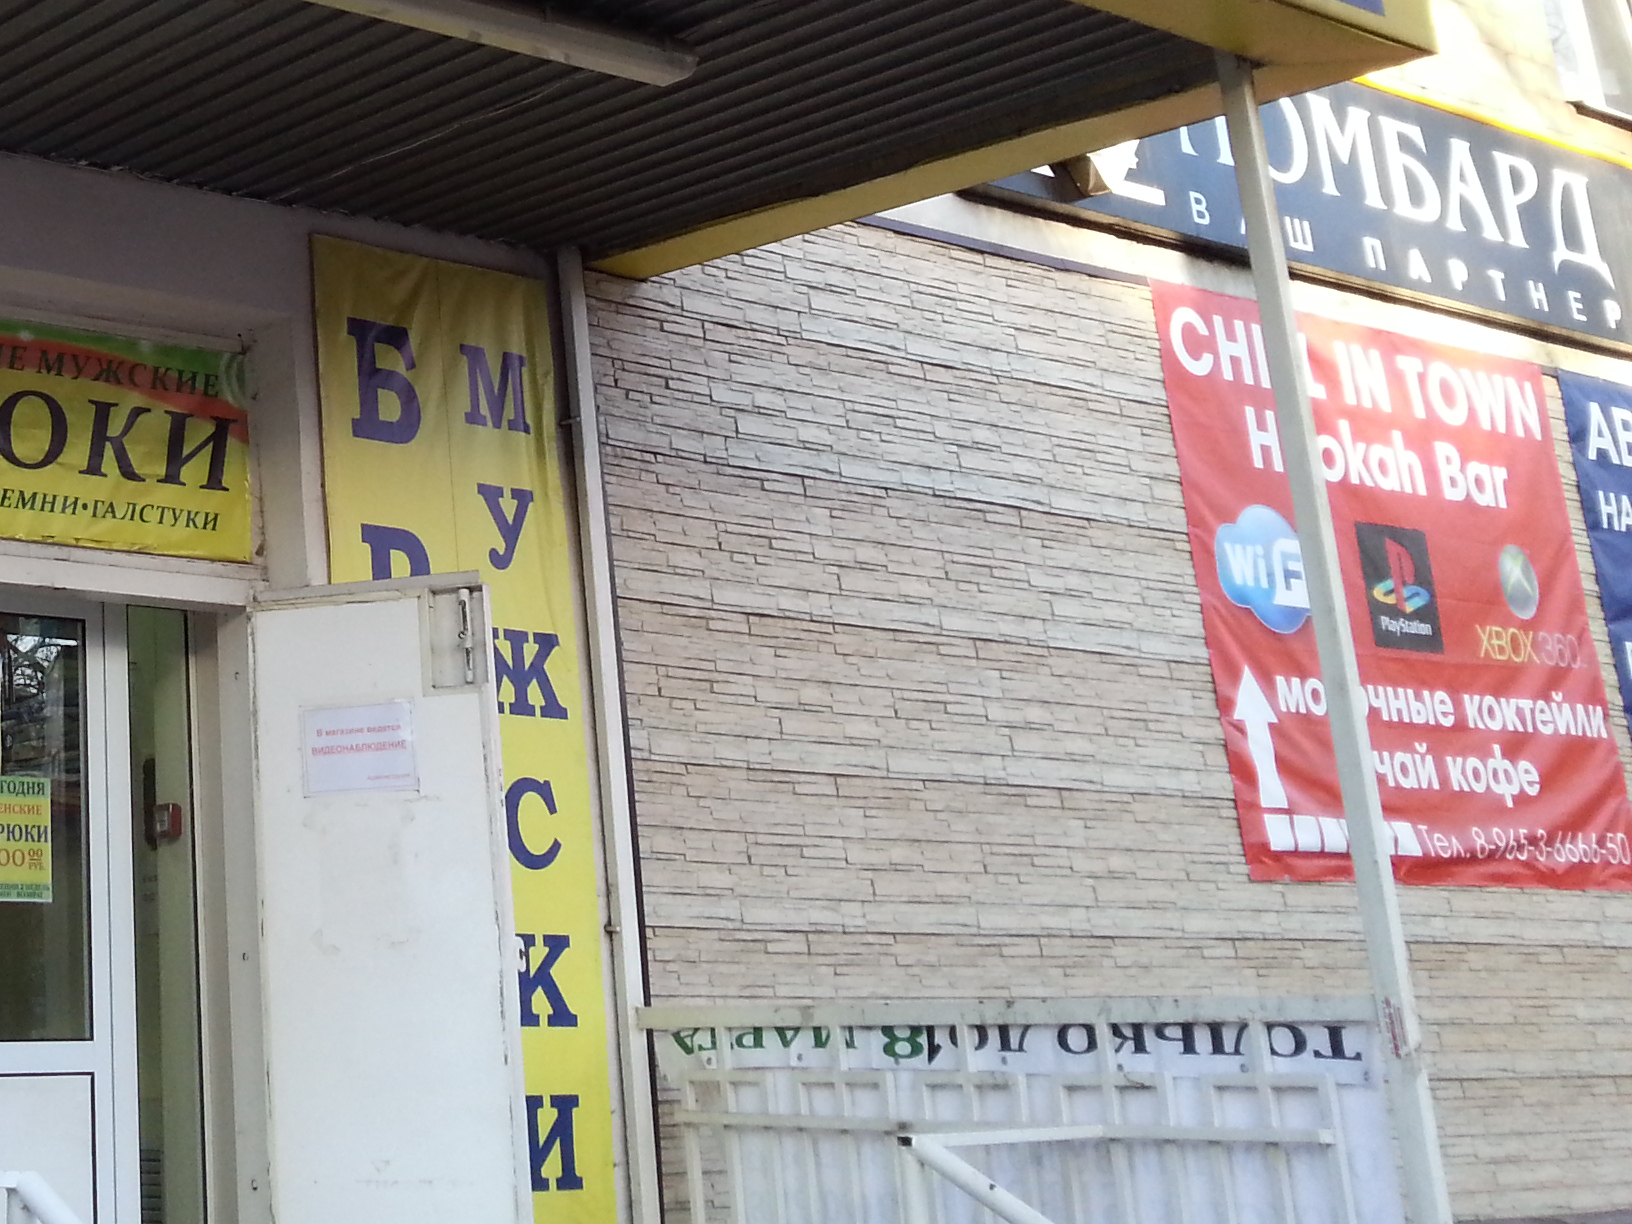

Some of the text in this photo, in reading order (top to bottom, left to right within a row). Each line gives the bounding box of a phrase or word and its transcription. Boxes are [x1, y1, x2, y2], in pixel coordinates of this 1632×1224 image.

[1189, 190, 1622, 329] ВШ ПАРТНЕР
[36, 349, 221, 398] МУЖСКИЕ
[1169, 307, 1542, 441] CHIL IN TOWN
[1245, 407, 1509, 509] Hokah Bar
[91, 499, 220, 532] ГАЛСТУКИ
[1380, 616, 1434, 637] PlayStation
[1476, 625, 1539, 664] XBOX
[1275, 675, 1608, 738] мочные коктейли
[311, 739, 407, 756] ВИДЕОНАБЛЮДЕНИЕ
[459, 343, 585, 1192] МУЖСКИ
[1446, 744, 1541, 807] кофе
